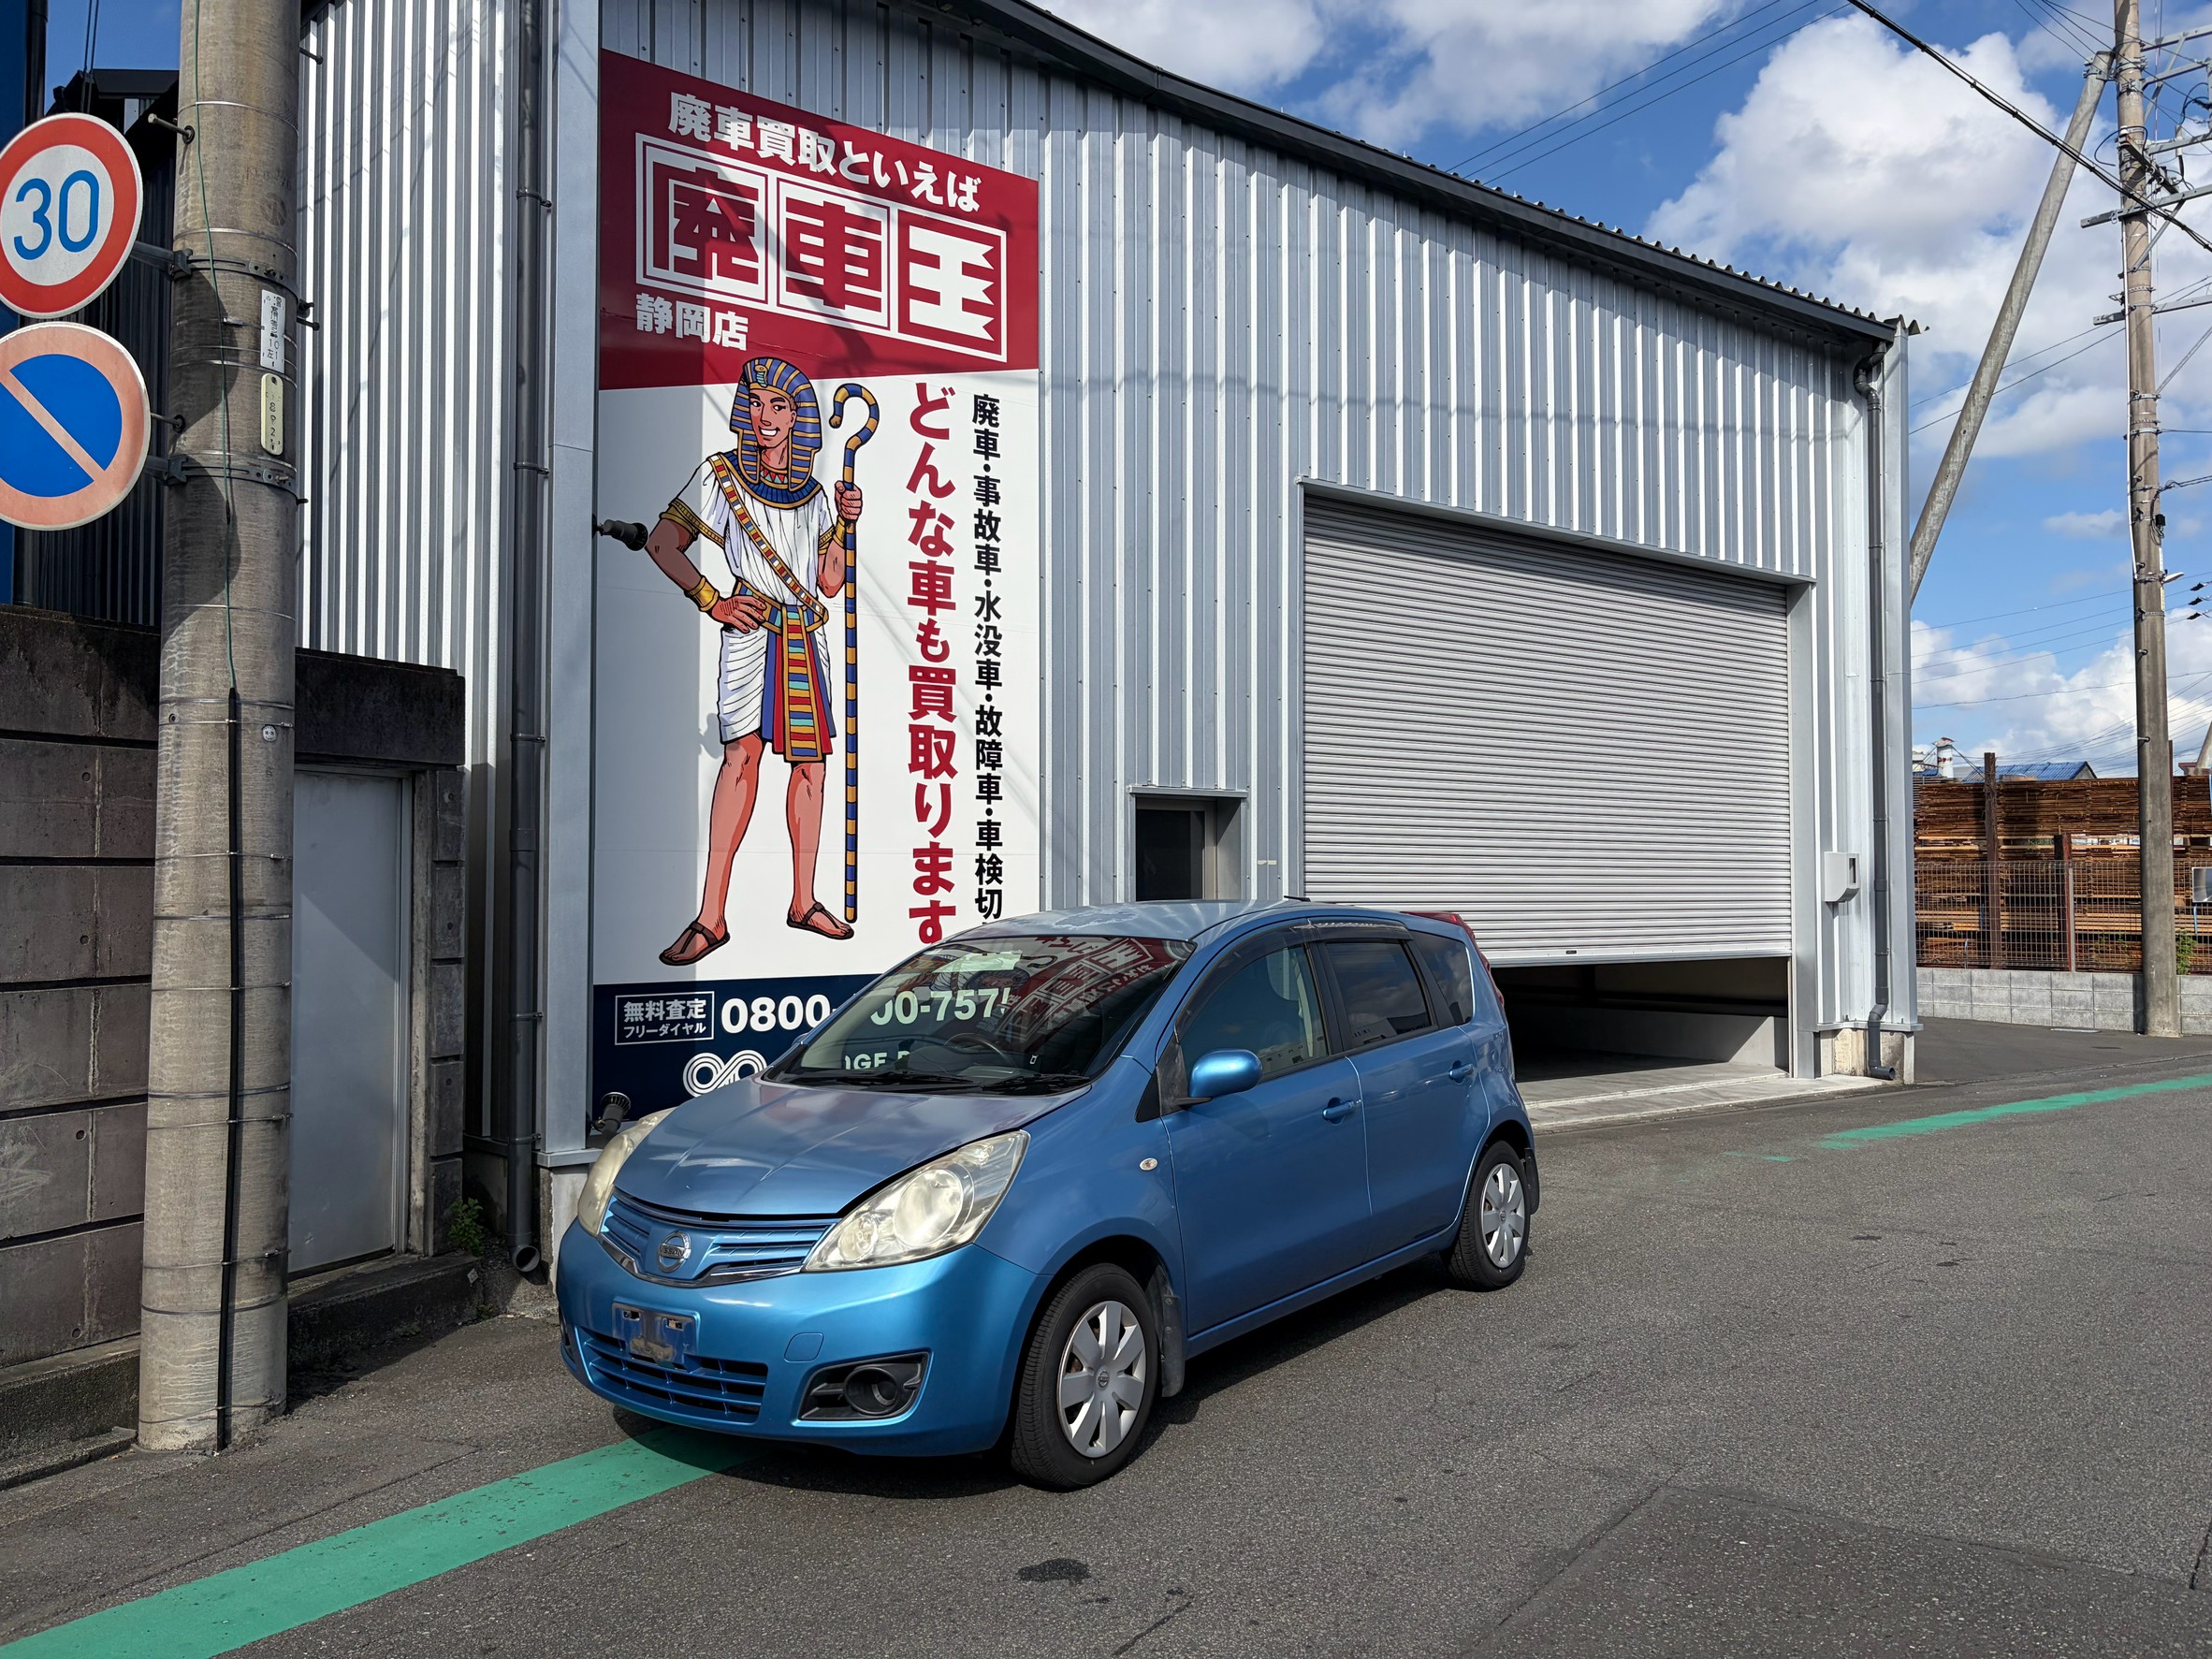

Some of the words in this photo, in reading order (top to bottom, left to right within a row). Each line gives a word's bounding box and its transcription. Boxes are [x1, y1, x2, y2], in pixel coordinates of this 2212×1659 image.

[668, 92, 981, 212] 廃車買取といえば
[13, 169, 99, 261] 30
[636, 293, 749, 351] 静岡店
[906, 382, 958, 945] どんな車も買取ります
[972, 393, 1003, 924] 廃車・事故車・水没車・故障車・車検切
[623, 997, 707, 1023] 無料査定
[623, 1022, 707, 1040] フリーダイヤル
